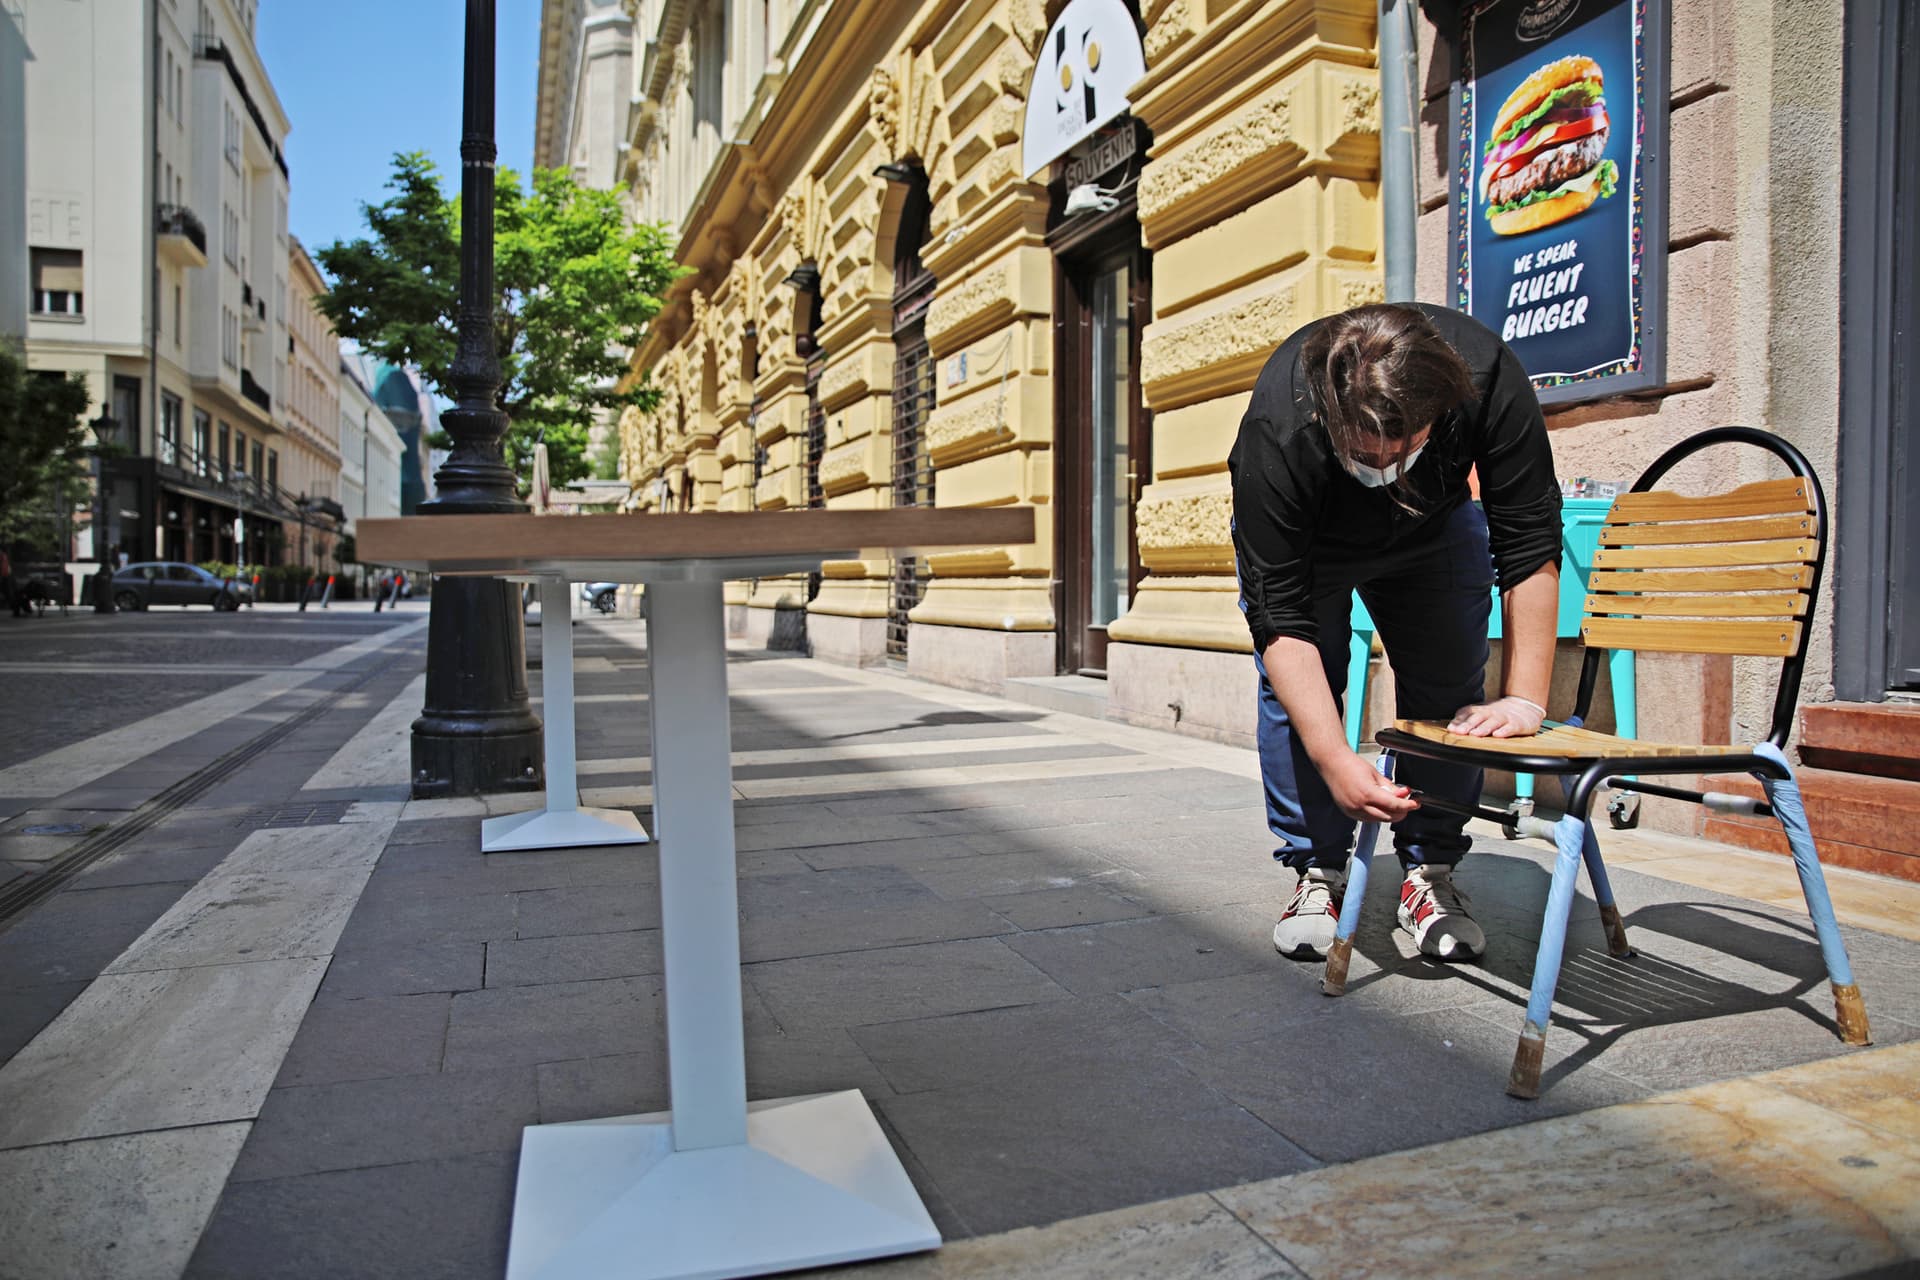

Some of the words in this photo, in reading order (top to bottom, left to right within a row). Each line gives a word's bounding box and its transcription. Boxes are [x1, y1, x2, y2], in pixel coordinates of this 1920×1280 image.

[1068, 128, 1133, 190] SOUVENIR
[1513, 253, 1534, 274] WE
[1535, 240, 1577, 268] SPEAK
[1507, 263, 1584, 308] FLUENT
[1502, 295, 1588, 342] BURGER
